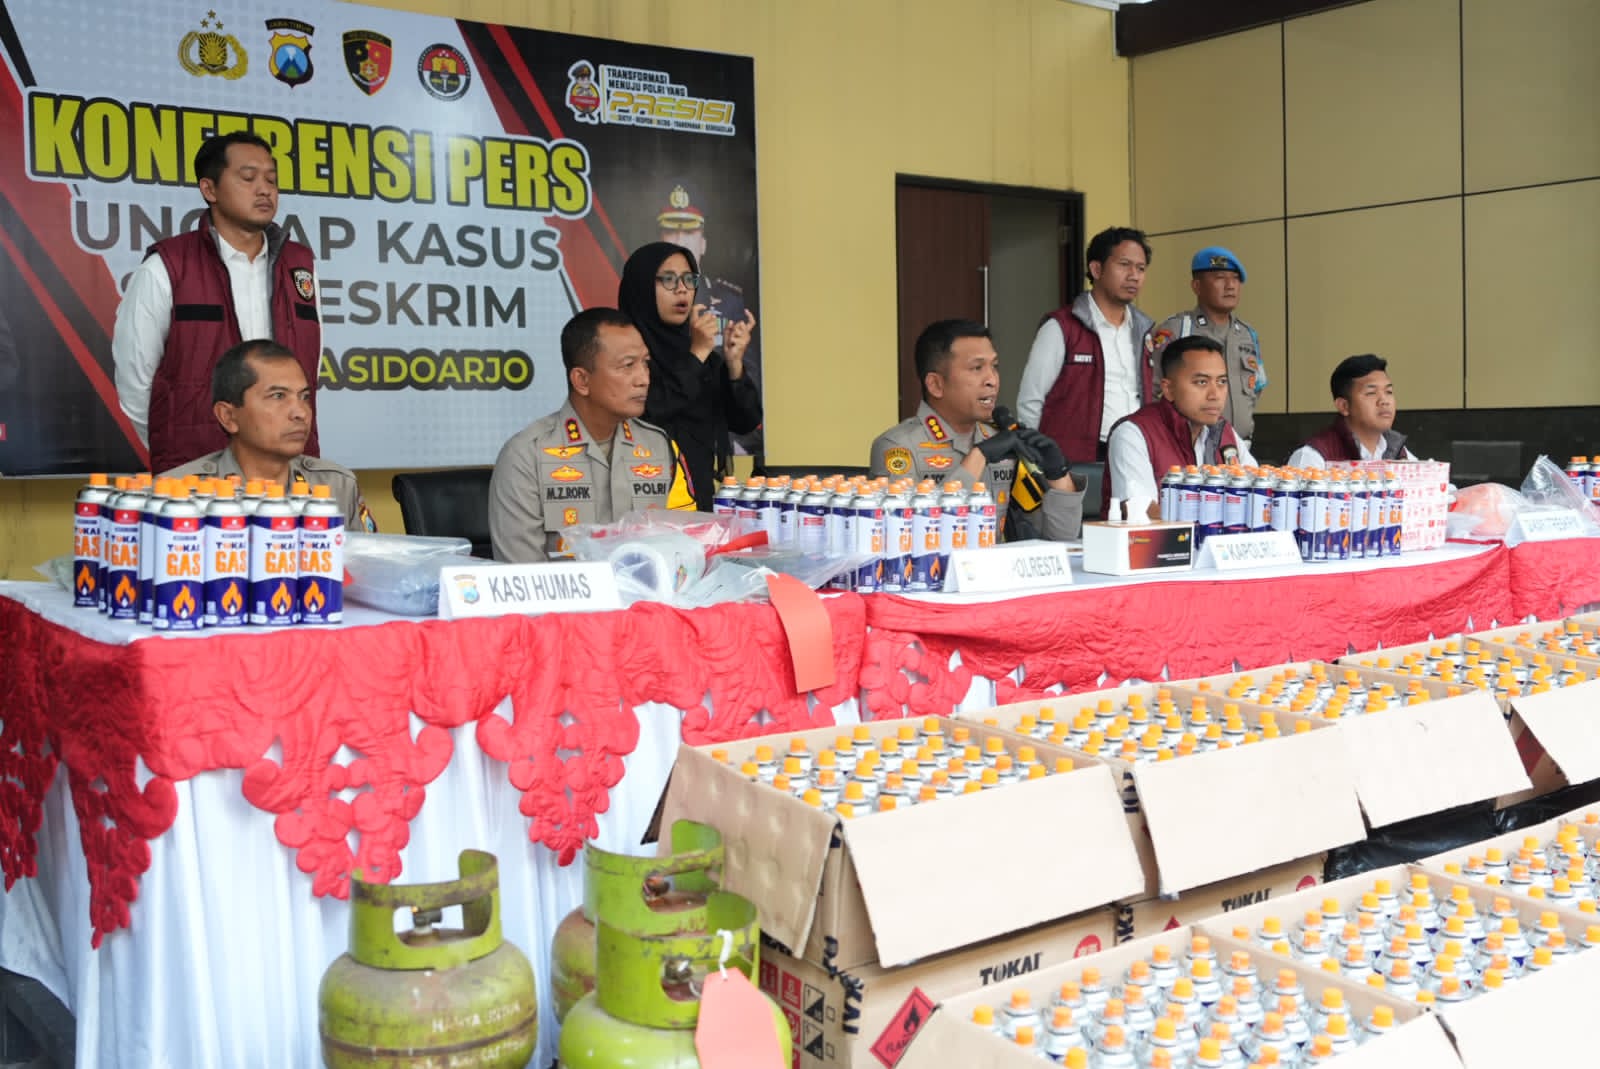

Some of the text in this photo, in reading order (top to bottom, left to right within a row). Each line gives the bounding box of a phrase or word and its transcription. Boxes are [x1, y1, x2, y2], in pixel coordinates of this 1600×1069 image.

[607, 68, 668, 83] TRANSFORMASI
[608, 80, 686, 97] MENUJU POLRI YANG
[608, 90, 734, 125] PRESISI
[31, 95, 588, 213] KONFRENSI PERS
[76, 199, 560, 272] UNAP KASUS
[347, 354, 529, 385] SIDOARJO
[632, 482, 667, 496] POLRI
[74, 535, 100, 557] GAS
[111, 534, 138, 543] TOKA
[166, 553, 200, 577] GAS
[215, 551, 246, 573] GAS
[265, 551, 296, 574] GAS
[300, 550, 332, 573] GAS
[1014, 555, 1065, 579] OLRESTA
[488, 573, 592, 603] KASI HUMAS
[979, 952, 1044, 986] TOKAI
